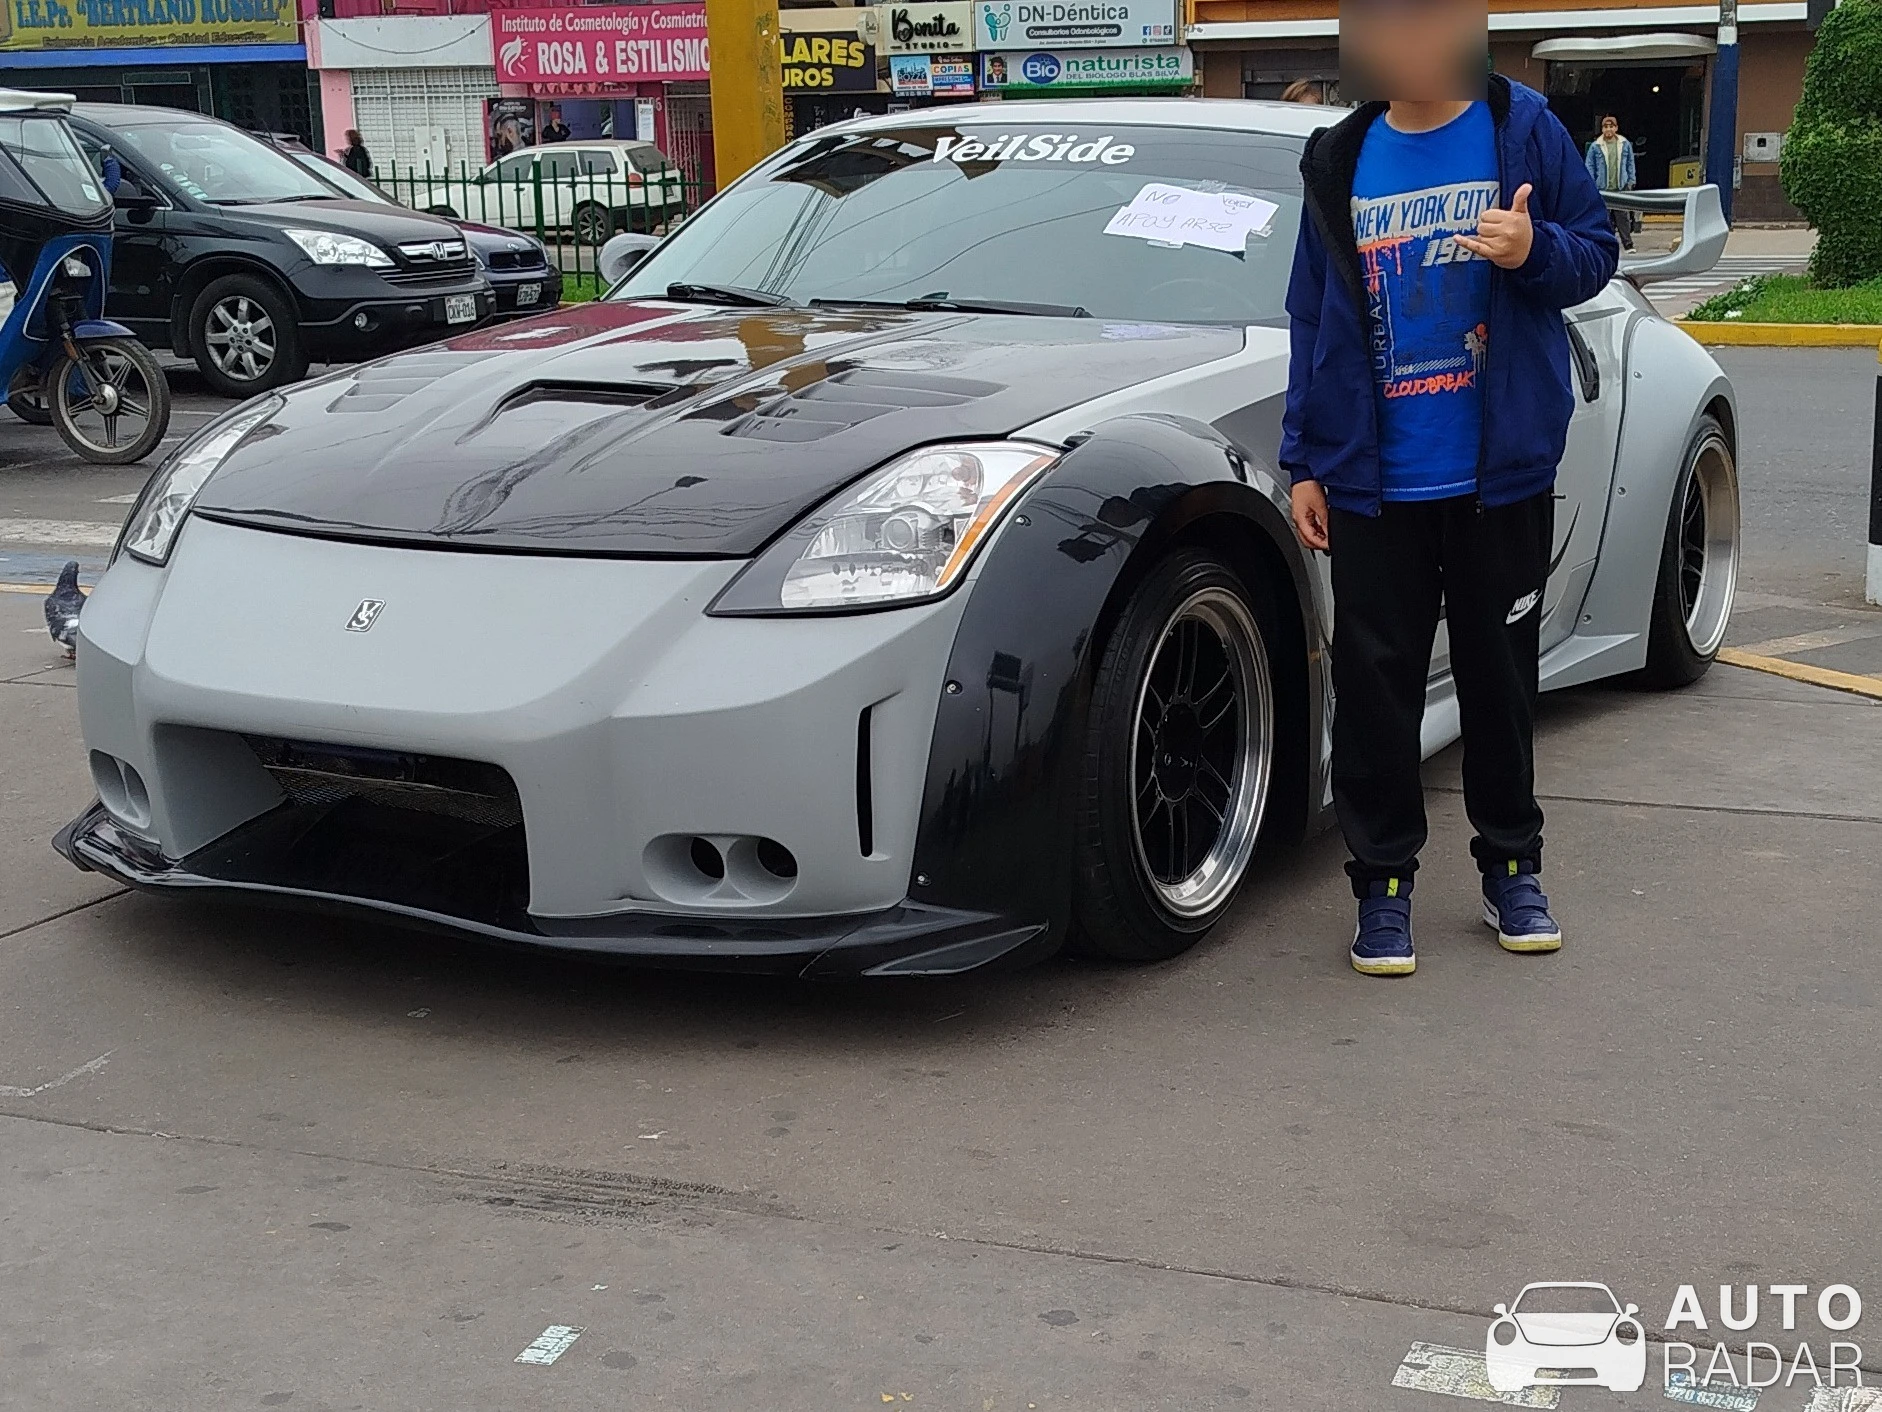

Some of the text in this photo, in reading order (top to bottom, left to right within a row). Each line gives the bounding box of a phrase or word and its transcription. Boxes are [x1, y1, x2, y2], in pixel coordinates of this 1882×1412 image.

[501, 13, 547, 33] Instituto
[549, 13, 563, 32] de
[565, 11, 639, 36] Cosmetología
[641, 16, 649, 35] y
[1018, 3, 1129, 23] DN-Déntica
[891, 8, 961, 42] Bonita
[1029, 26, 1118, 37] Consultorios Odontológicos
[779, 37, 866, 68] LARES
[904, 42, 950, 50] STUDIO
[537, 41, 588, 75] ROSA
[595, 40, 610, 75] &
[1066, 53, 1180, 72] naturista
[933, 64, 970, 74] COPIAS
[1026, 62, 1060, 78] Bio
[1129, 70, 1153, 78] BLAS
[1155, 69, 1180, 77] SILVA
[932, 134, 1136, 165] VeilSide
[1145, 190, 1182, 205] NO
[1355, 187, 1500, 240] NEW YORK CITY
[1383, 370, 1476, 399] CLOUDBREAK
[1511, 588, 1539, 614] NIKE
